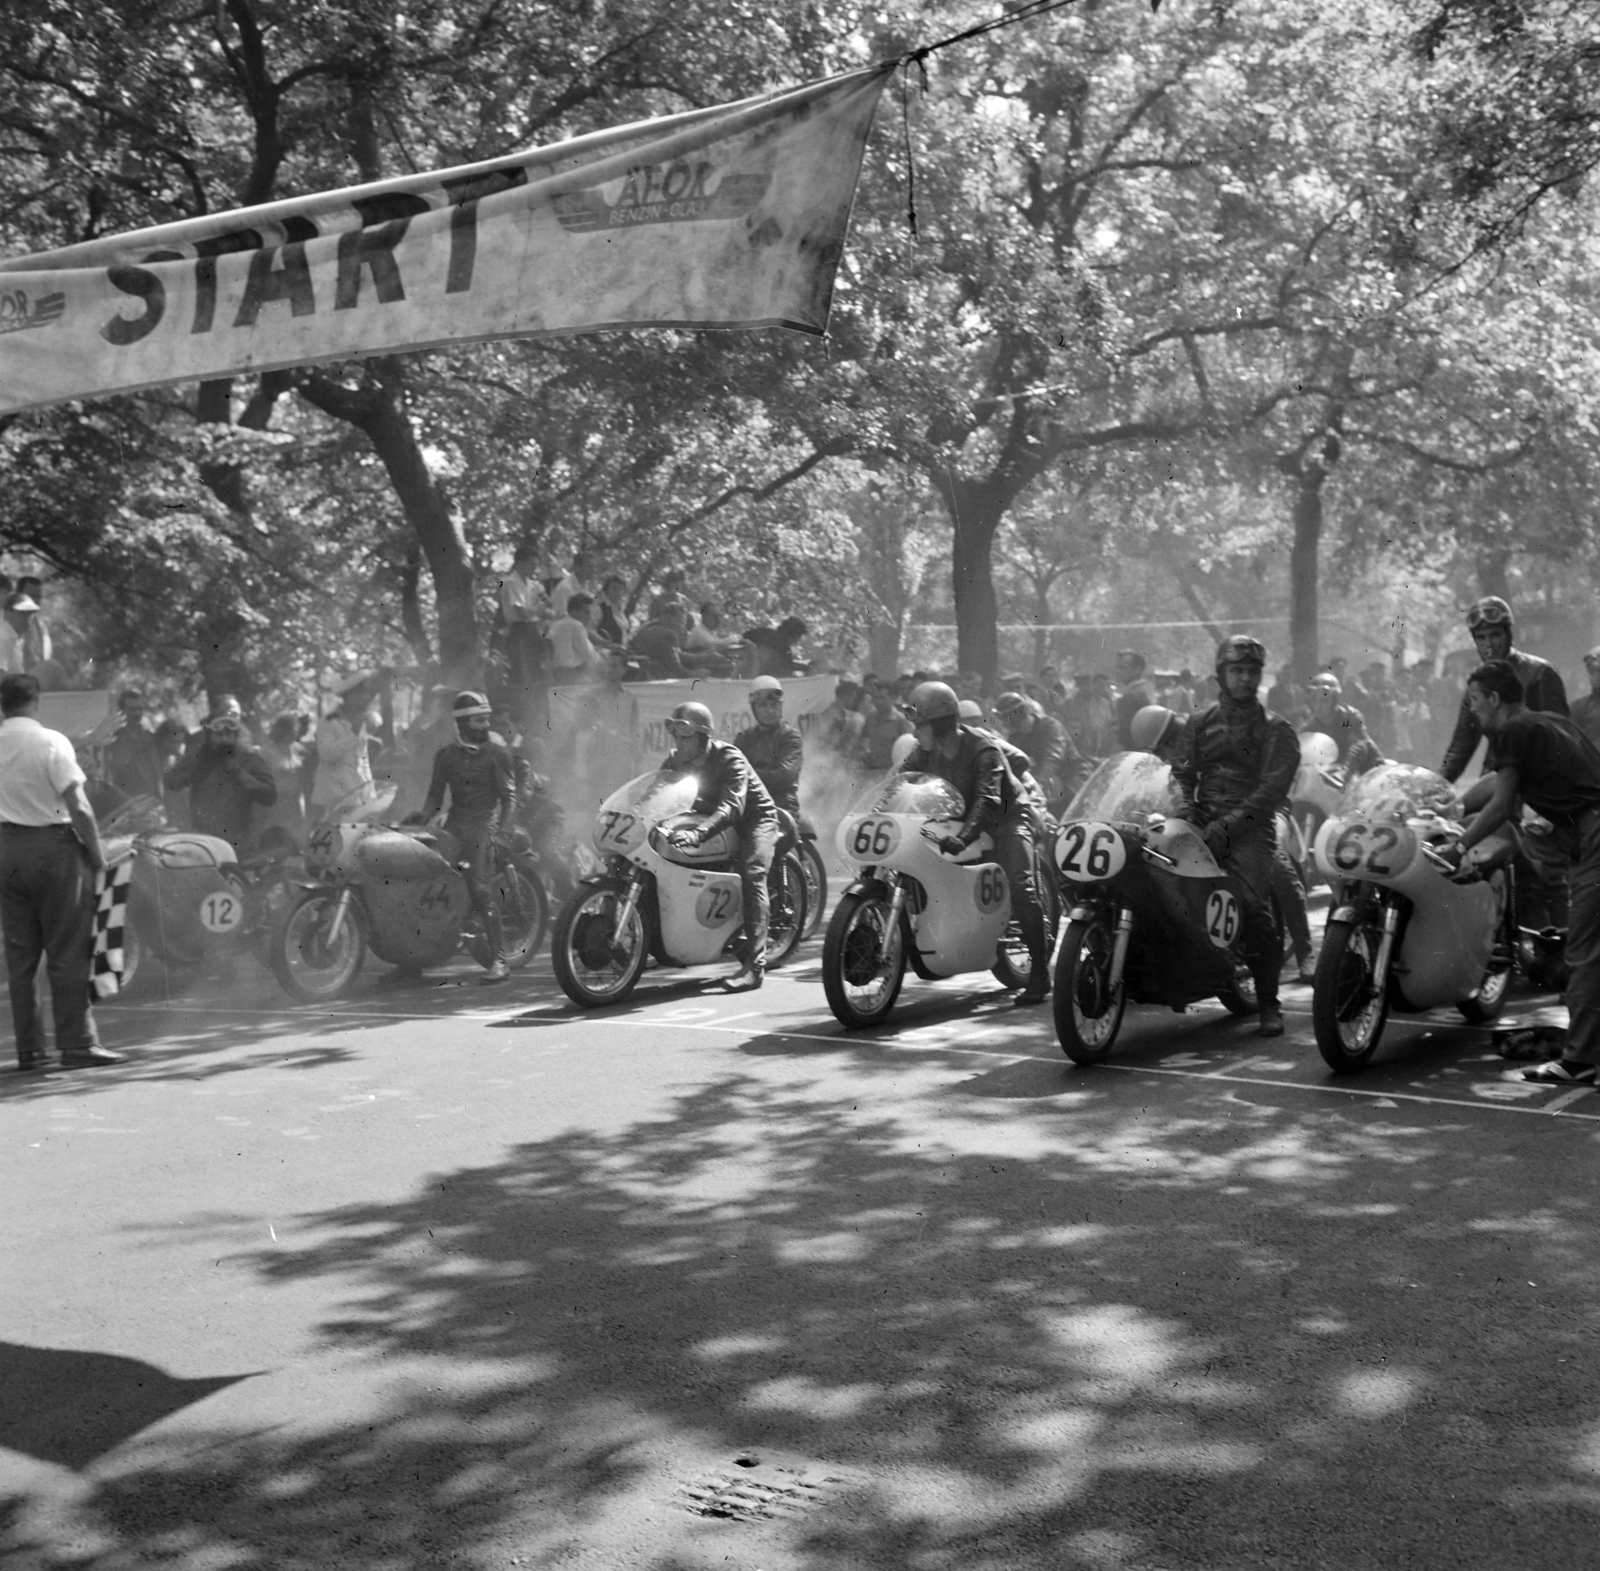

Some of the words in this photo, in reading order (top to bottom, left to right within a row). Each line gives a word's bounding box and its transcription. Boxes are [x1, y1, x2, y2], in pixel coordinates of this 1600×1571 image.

[100, 167, 529, 346] START
[309, 827, 333, 854] 44
[601, 811, 636, 844] 72
[854, 820, 894, 855] 66
[1061, 825, 1115, 877] 26
[1335, 824, 1398, 875] 62
[420, 883, 450, 910] 44
[706, 887, 731, 920] 72
[980, 867, 1004, 905] 66
[208, 899, 233, 925] 12
[1210, 892, 1236, 941] 26
